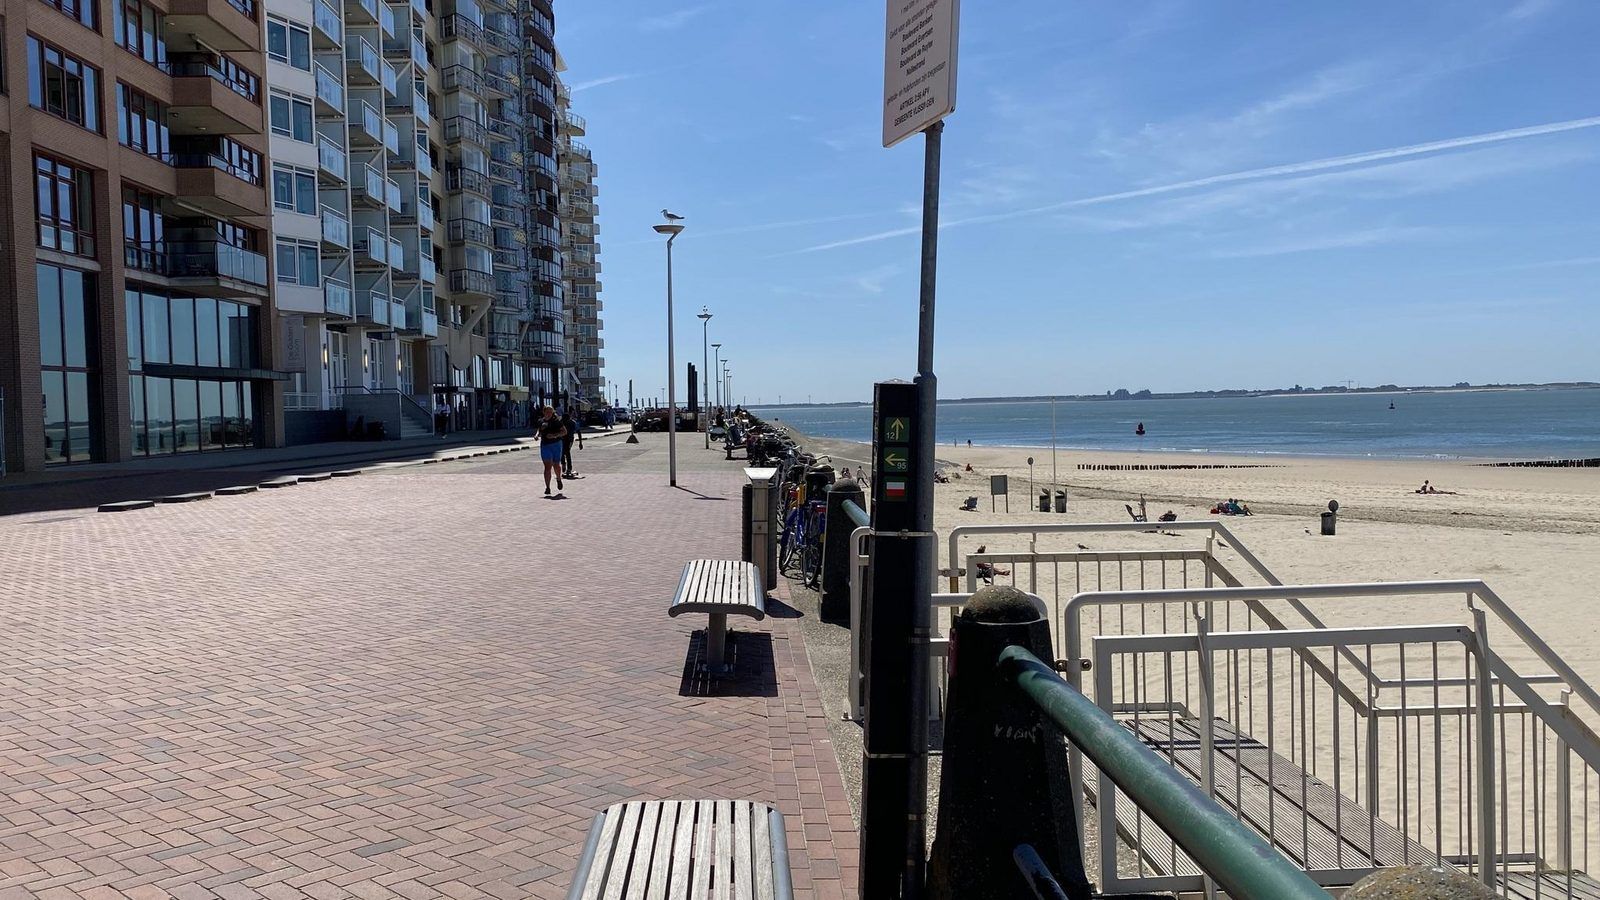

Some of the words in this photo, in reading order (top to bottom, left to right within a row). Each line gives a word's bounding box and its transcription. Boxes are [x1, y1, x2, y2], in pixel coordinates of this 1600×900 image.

[902, 26, 919, 42] Boulevard
[901, 38, 918, 55] Boulevard
[900, 51, 917, 68] Boulevard
[894, 109, 913, 127] GEMEENTE
[886, 432, 895, 440] 12
